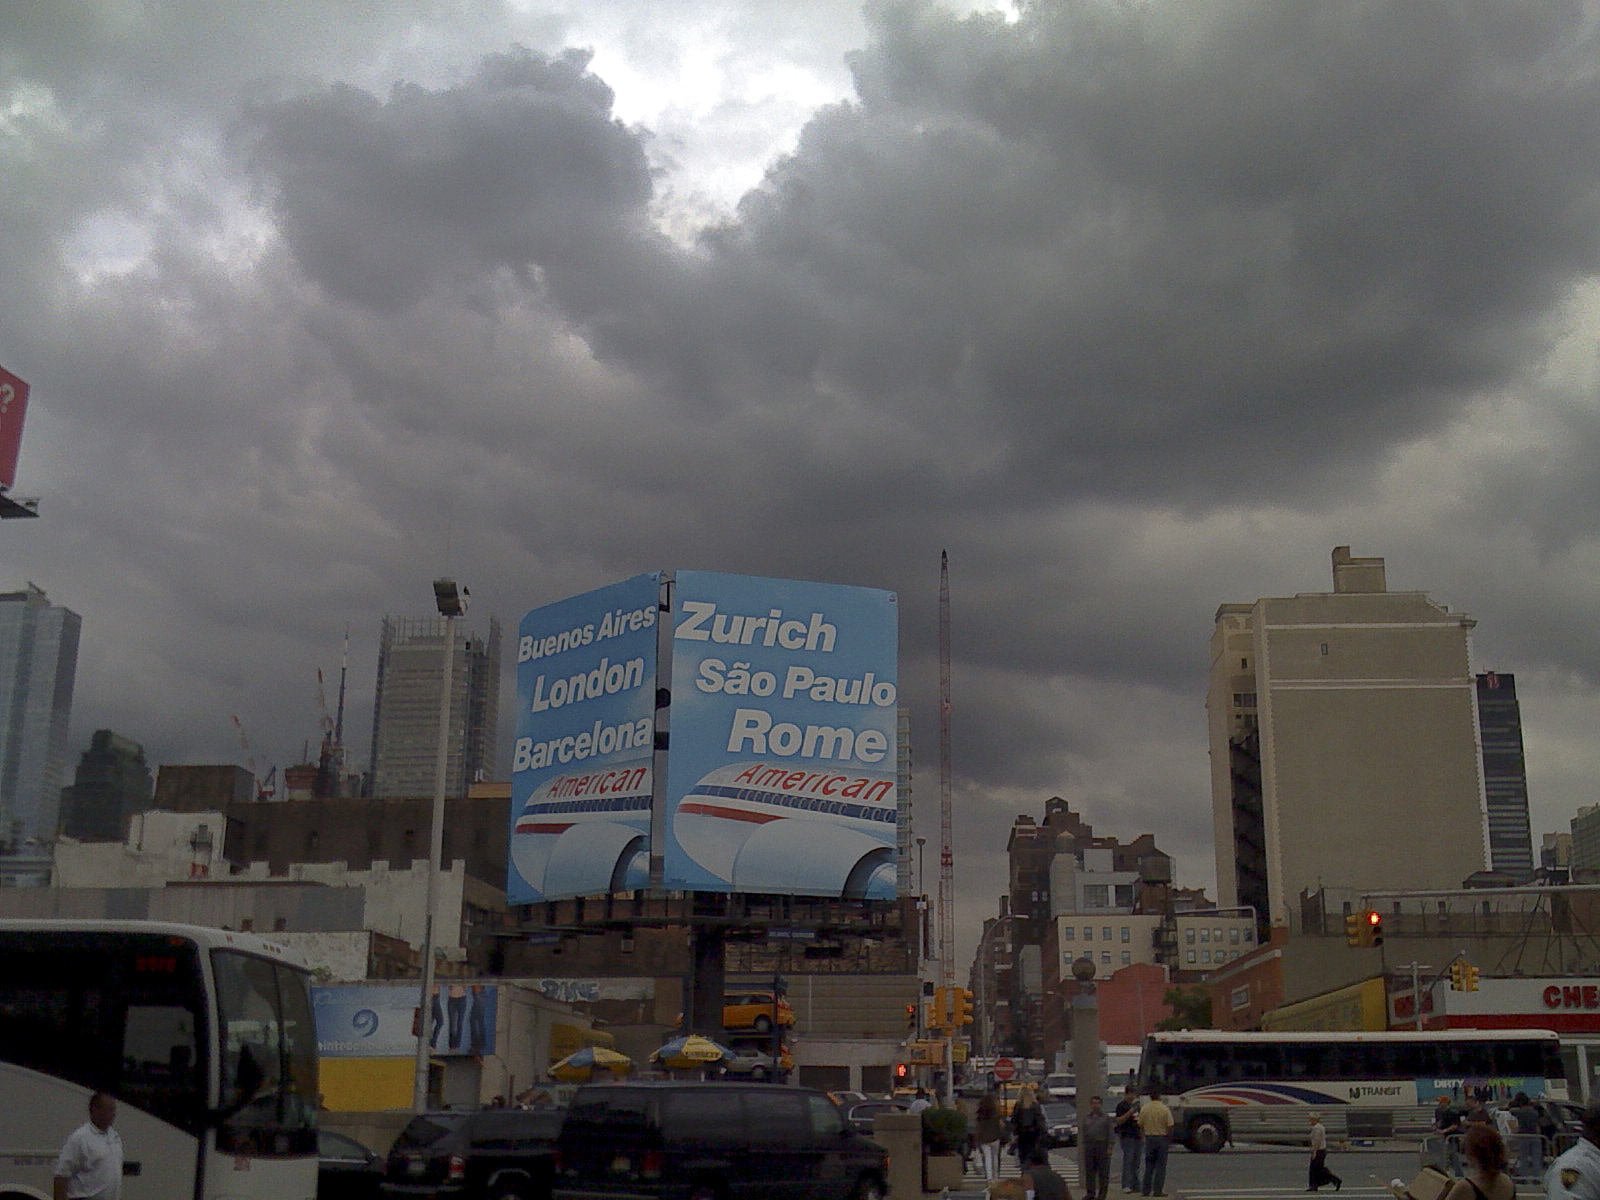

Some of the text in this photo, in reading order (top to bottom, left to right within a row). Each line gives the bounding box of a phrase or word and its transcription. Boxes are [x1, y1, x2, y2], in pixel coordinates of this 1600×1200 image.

[517, 604, 657, 664] Buenos Aires
[674, 600, 837, 652] Zurich
[531, 656, 644, 713] London
[695, 658, 897, 707] São Paulo
[512, 716, 653, 773] Barcelona
[726, 708, 888, 763] Rome
[546, 765, 648, 799] American
[733, 763, 894, 803] American
[1543, 985, 1600, 1009] CHE
[1361, 1086, 1402, 1096] TRANSIT
[1433, 1078, 1464, 1089] DIRTY
